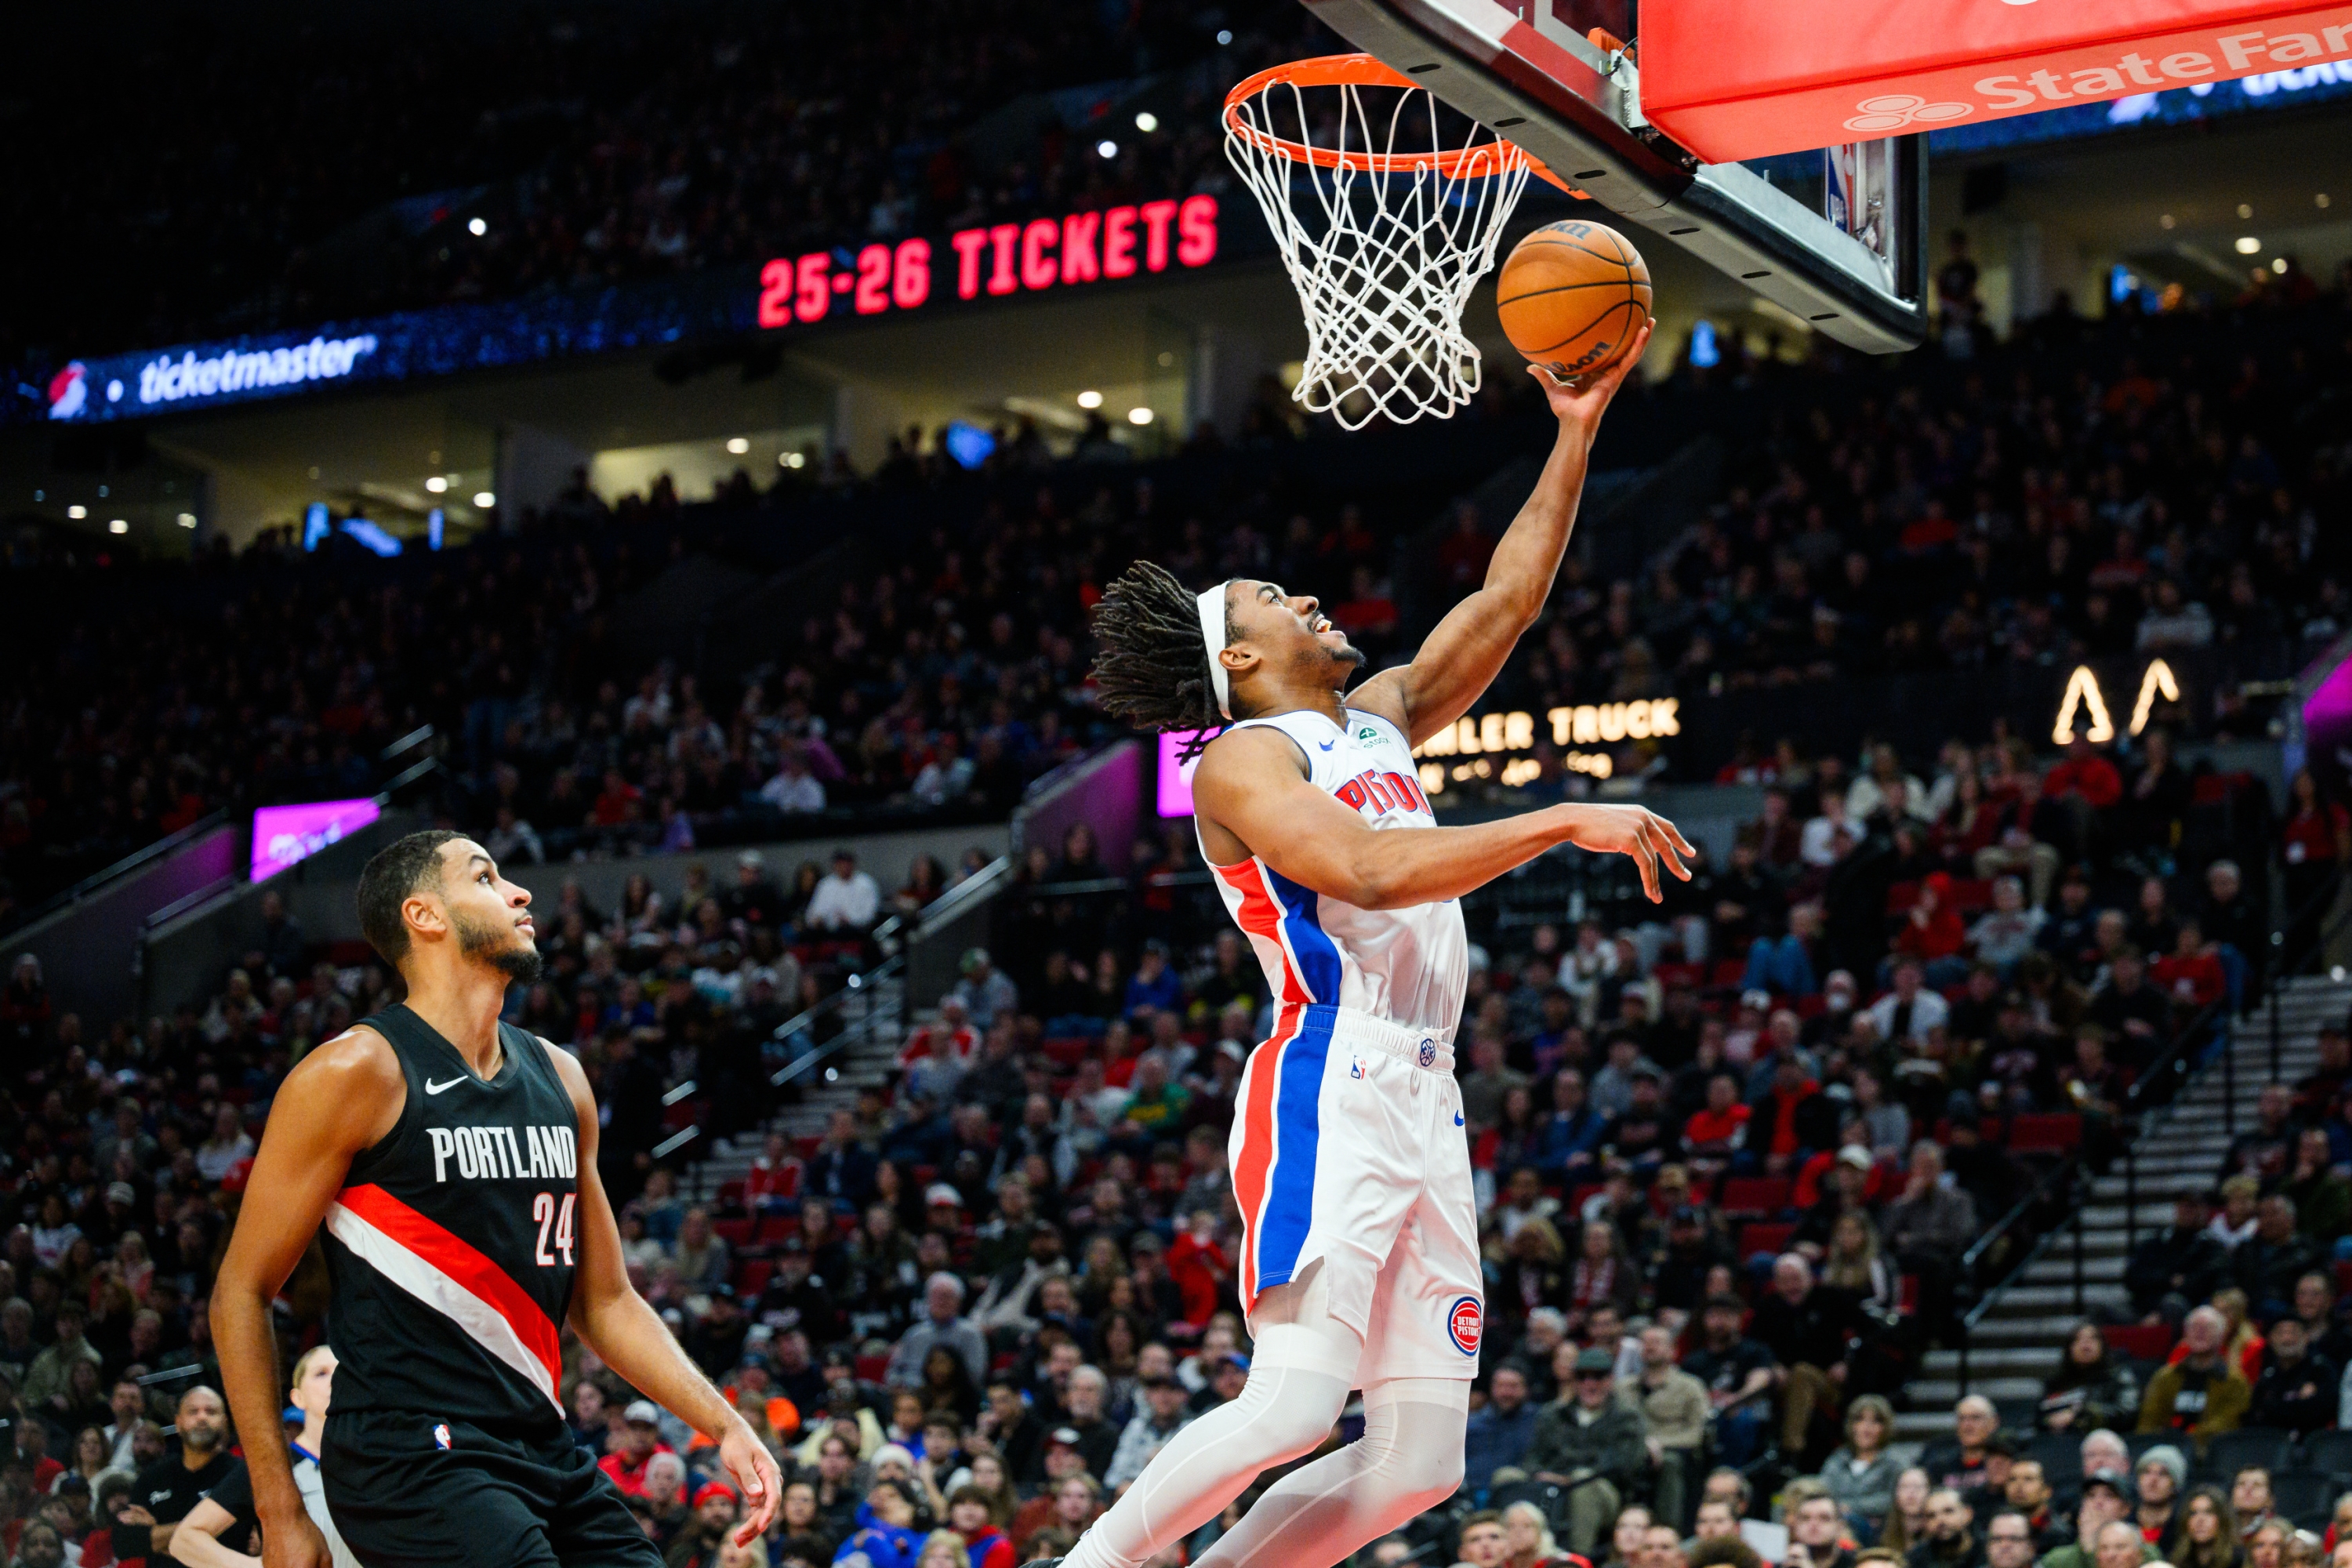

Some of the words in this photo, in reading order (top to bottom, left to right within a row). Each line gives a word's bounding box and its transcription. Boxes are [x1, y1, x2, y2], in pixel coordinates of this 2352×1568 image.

[1973, 51, 2216, 110] State
[2217, 23, 2352, 71] Far
[758, 238, 931, 328] 25-26
[952, 194, 1218, 300] TICKETS
[140, 335, 367, 403] ticketmaster
[1548, 697, 1680, 746] TRUCK
[425, 1126, 577, 1182] PORTLAND
[533, 1192, 577, 1266] 24
[1457, 1316, 1479, 1327] DETROIT
